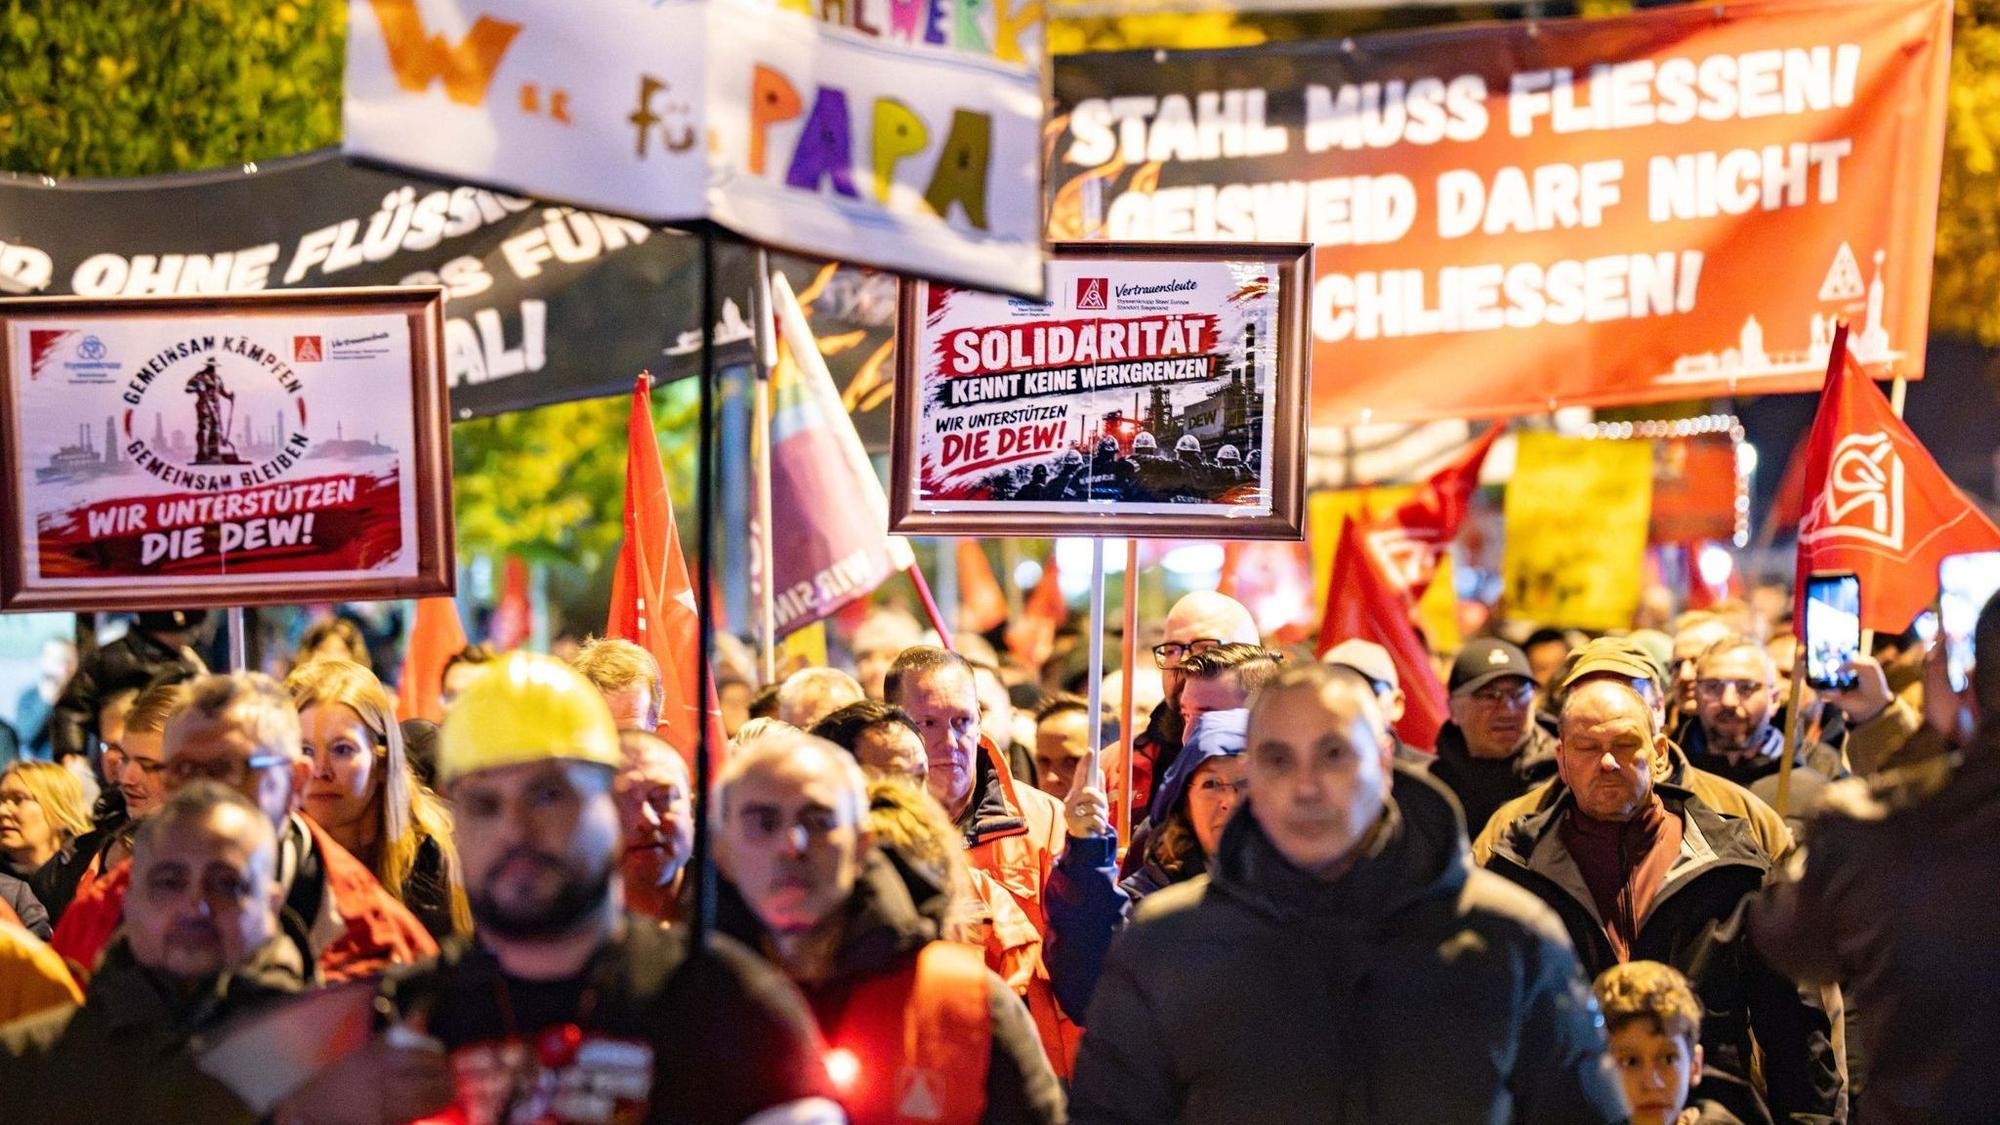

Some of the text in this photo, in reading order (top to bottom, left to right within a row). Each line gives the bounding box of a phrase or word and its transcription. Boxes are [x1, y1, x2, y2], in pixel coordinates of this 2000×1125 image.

[1069, 43, 1861, 167] STAHL MUSS FLIESSEN!
[748, 62, 994, 232] PAPA
[1107, 137, 1852, 247] GEISWEID DARF NICHT
[71, 242, 280, 296] OHNE
[284, 186, 536, 284] FLÜSSI
[1115, 279, 1198, 298] Vertrauensleute
[123, 336, 215, 406] GEMEINSAM
[223, 335, 304, 394] KÄMPFEN
[952, 314, 1206, 374] SOLIDARITÄT
[952, 357, 1216, 404] KENNT KEINE WERKGRENZEN!
[936, 404, 1068, 433] WIR UNTERSTÜTZEN
[941, 421, 1067, 467] DIE DEW!
[1188, 409, 1217, 428] DEW
[127, 432, 309, 492] GEMEINSAM BLEIBEN
[88, 478, 356, 538] WIR UNTERSTÜTZEN
[141, 512, 315, 566] DIE DEW!
